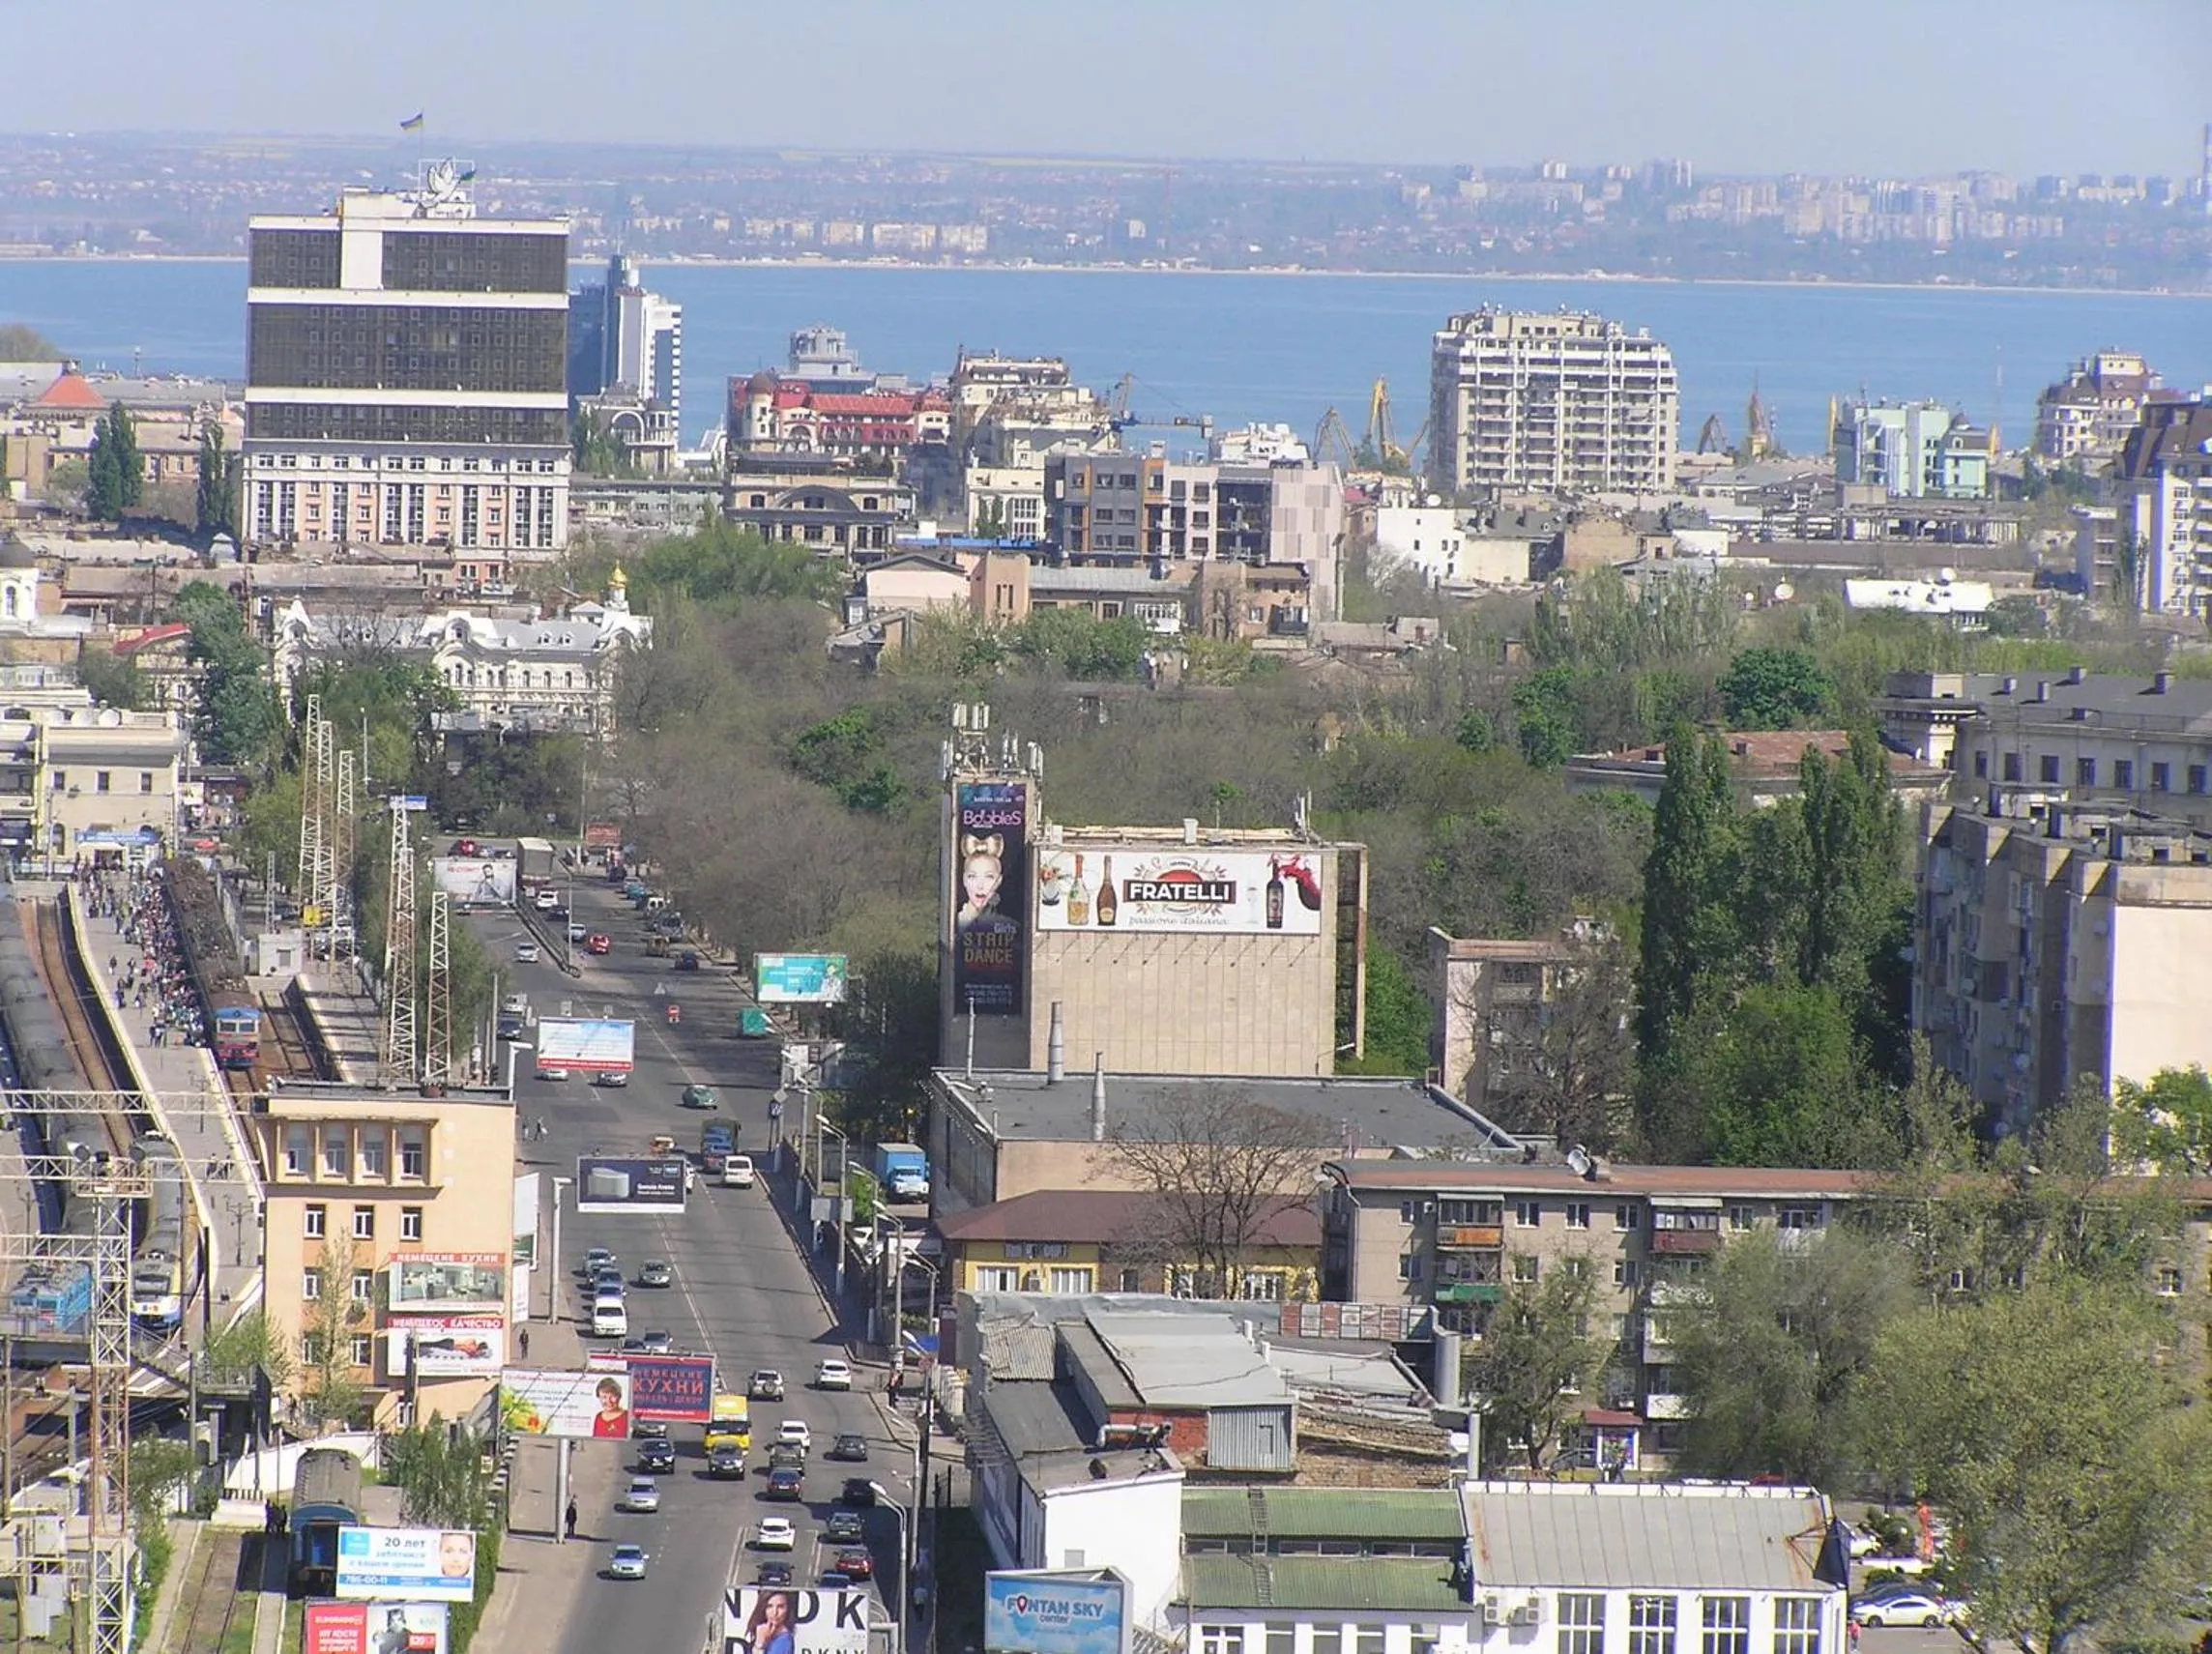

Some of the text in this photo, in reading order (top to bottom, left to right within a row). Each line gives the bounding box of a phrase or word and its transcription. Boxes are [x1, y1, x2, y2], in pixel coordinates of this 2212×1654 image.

[1129, 882, 1230, 901] FRATELLI
[963, 932, 1014, 946] STRIP
[965, 947, 1013, 964] DANCE
[461, 1254, 499, 1262] КУХНИ
[634, 1377, 704, 1395] КУХНИ
[385, 1536, 400, 1548] 20
[1072, 1601, 1104, 1617] SKY
[1038, 1614, 1068, 1624] center
